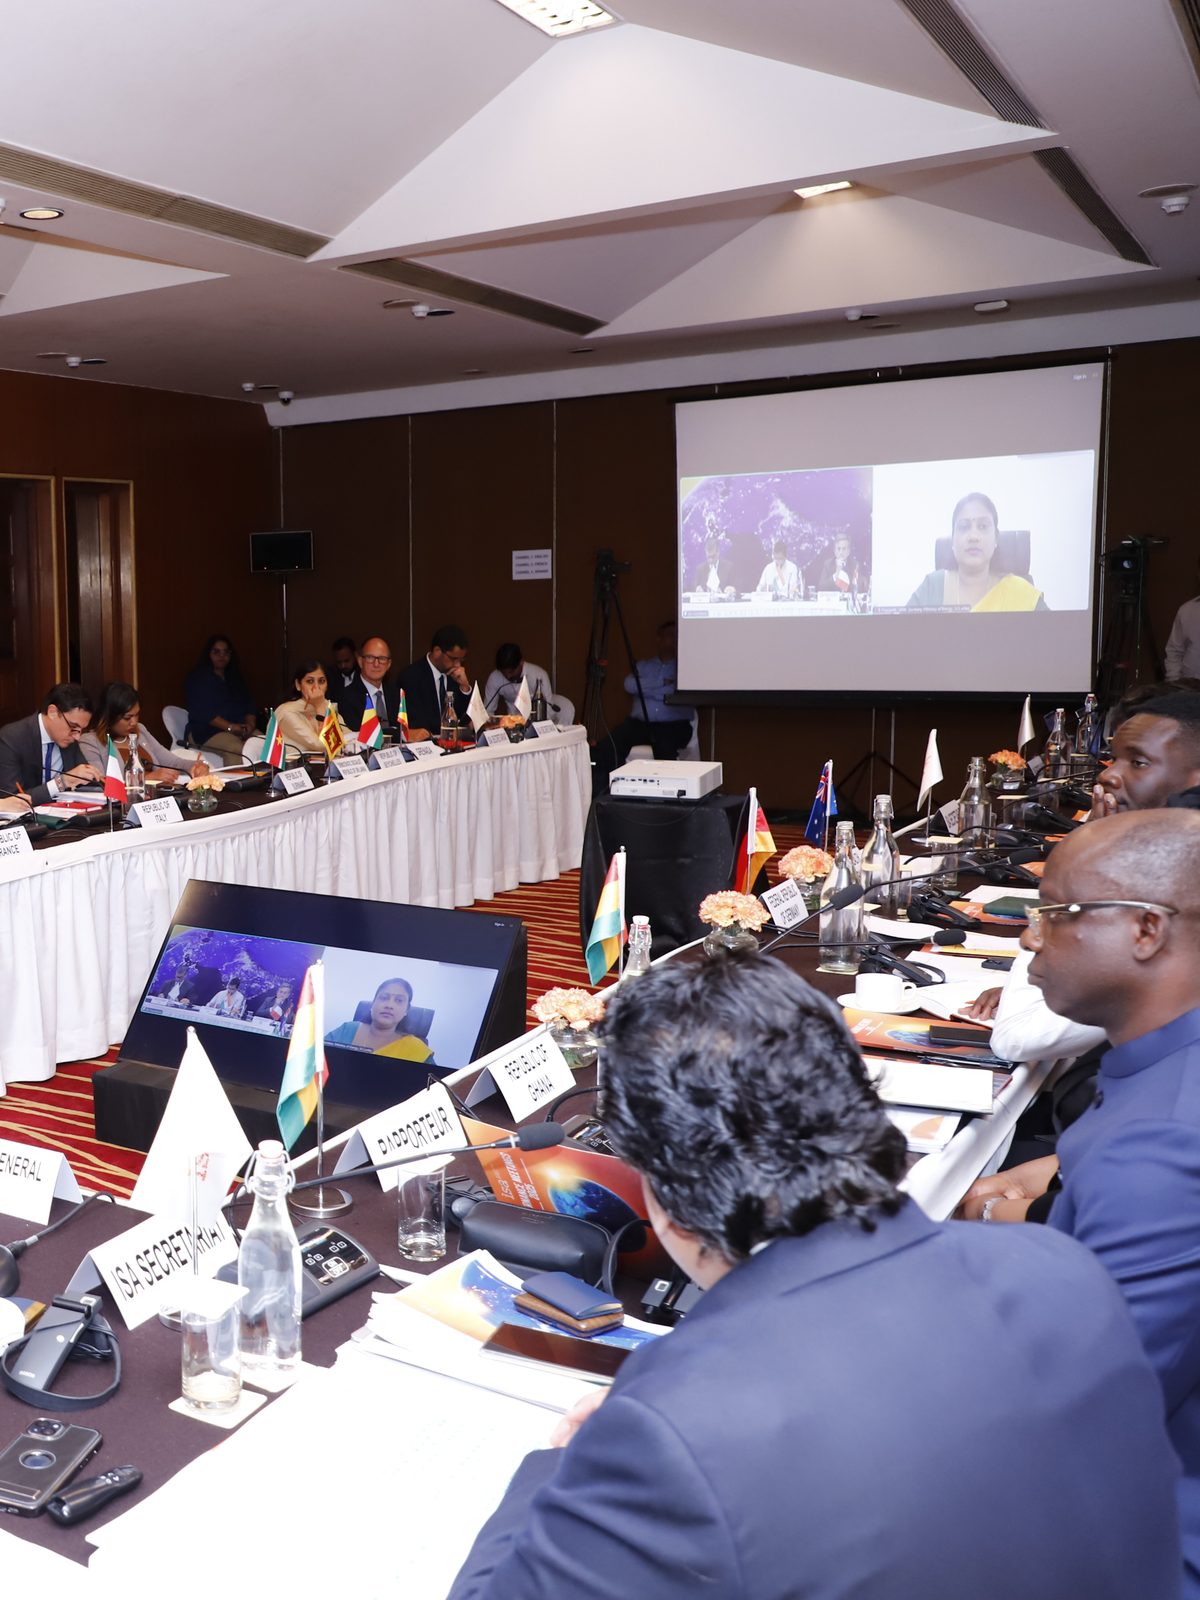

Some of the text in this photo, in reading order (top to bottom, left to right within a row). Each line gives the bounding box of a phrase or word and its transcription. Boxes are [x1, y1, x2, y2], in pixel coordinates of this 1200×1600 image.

[13, 830, 21, 840] OF
[504, 1043, 549, 1082] REPUBLIC OF
[528, 1074, 556, 1101] GHANA
[110, 1262, 145, 1301] ISA
